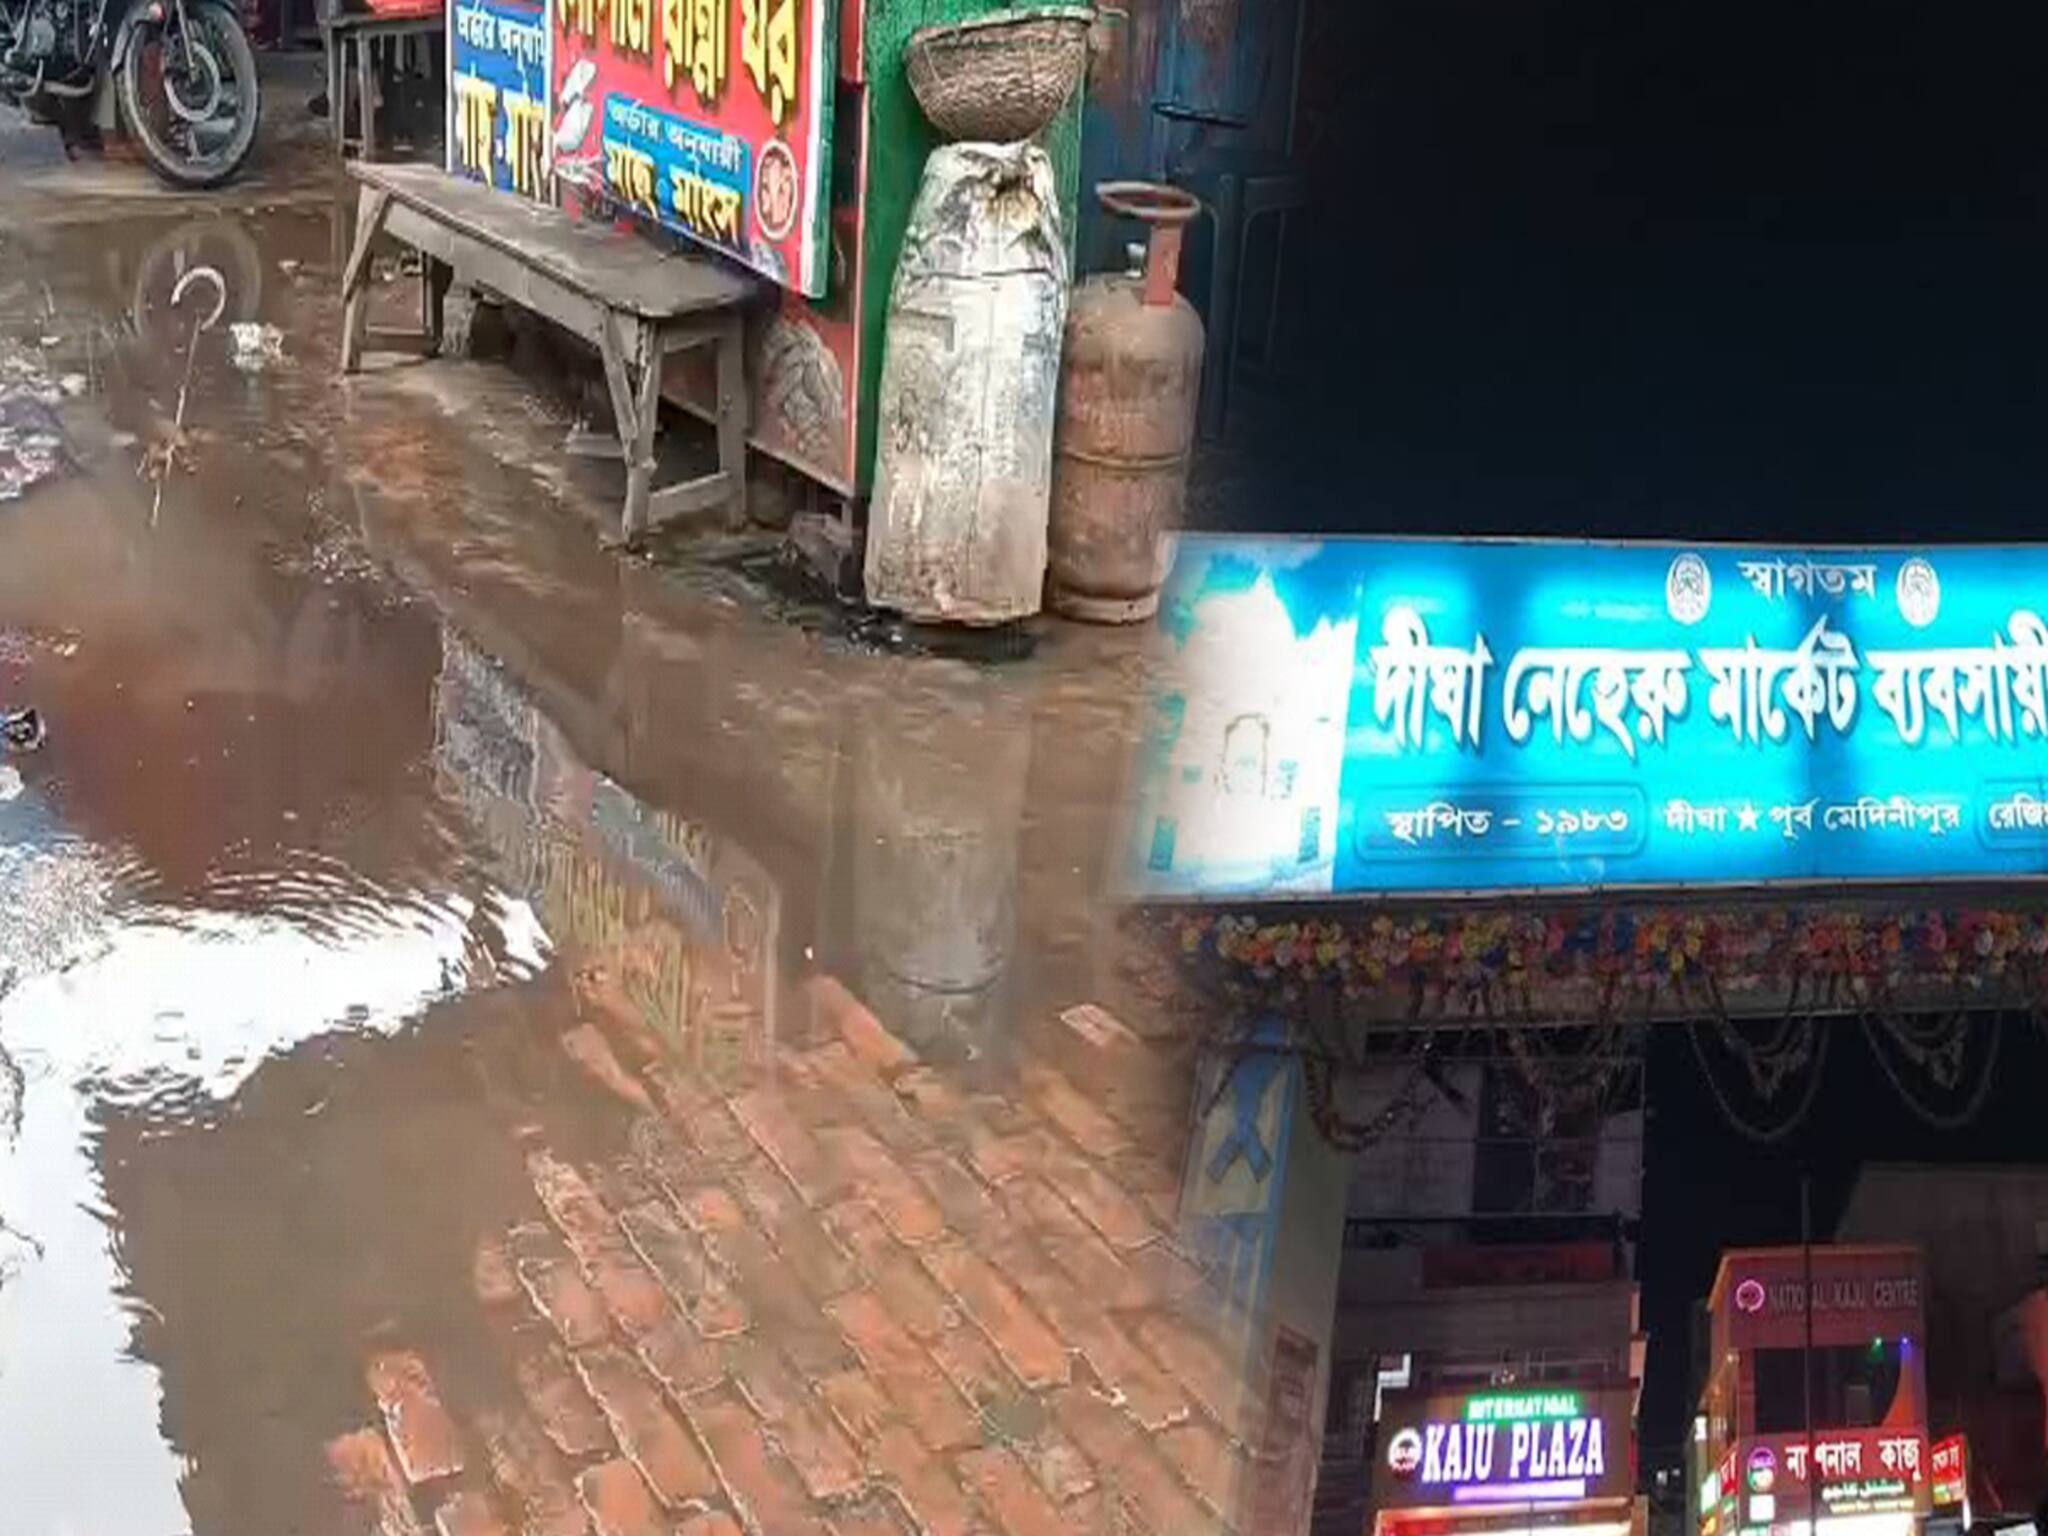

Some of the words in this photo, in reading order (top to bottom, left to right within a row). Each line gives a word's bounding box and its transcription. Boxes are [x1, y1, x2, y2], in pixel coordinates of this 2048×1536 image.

[1737, 558, 1877, 601] স্বাগতম
[1370, 604, 1495, 752] দীঘা
[1503, 646, 1695, 760] নেহেরু
[1700, 612, 1861, 750] মার্কেট
[1384, 801, 1493, 846] স্থাপিত
[1535, 809, 1629, 836] ১৯৮৩
[1665, 797, 1727, 834] দীঘা
[1770, 797, 1818, 842] পূর্ব
[1823, 795, 1960, 836] মেদিনীপুর
[1988, 791, 2048, 831] রেজি
[1768, 1282, 1824, 1313] NATIOAL
[1422, 1423, 1496, 1484] KAJU
[1509, 1417, 1605, 1479] PLAZA
[1878, 1437, 1922, 1482] কাজু
